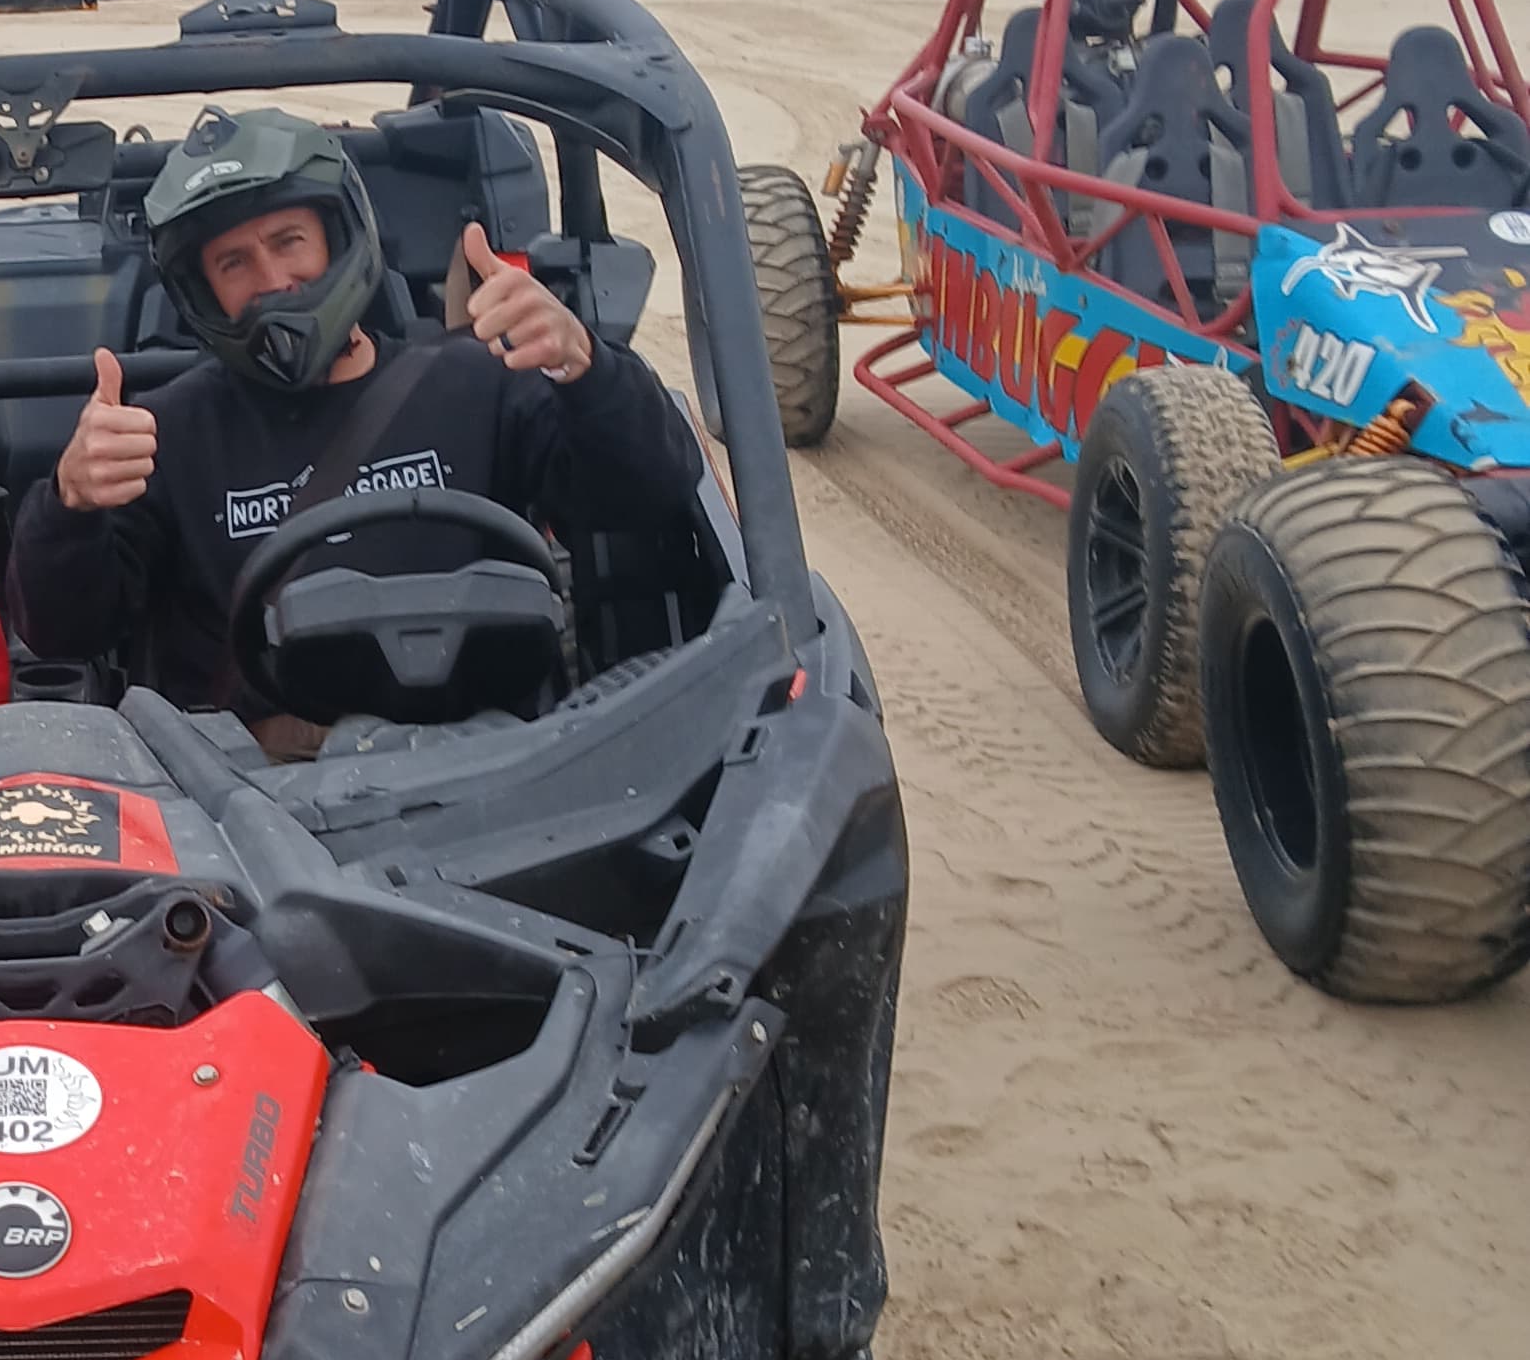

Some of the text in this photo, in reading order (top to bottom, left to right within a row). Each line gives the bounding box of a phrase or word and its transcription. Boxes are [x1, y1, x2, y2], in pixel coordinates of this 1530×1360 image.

[232, 491, 298, 527] NORT
[230, 1091, 282, 1224] TURBO
[3, 1227, 66, 1247] BRP
